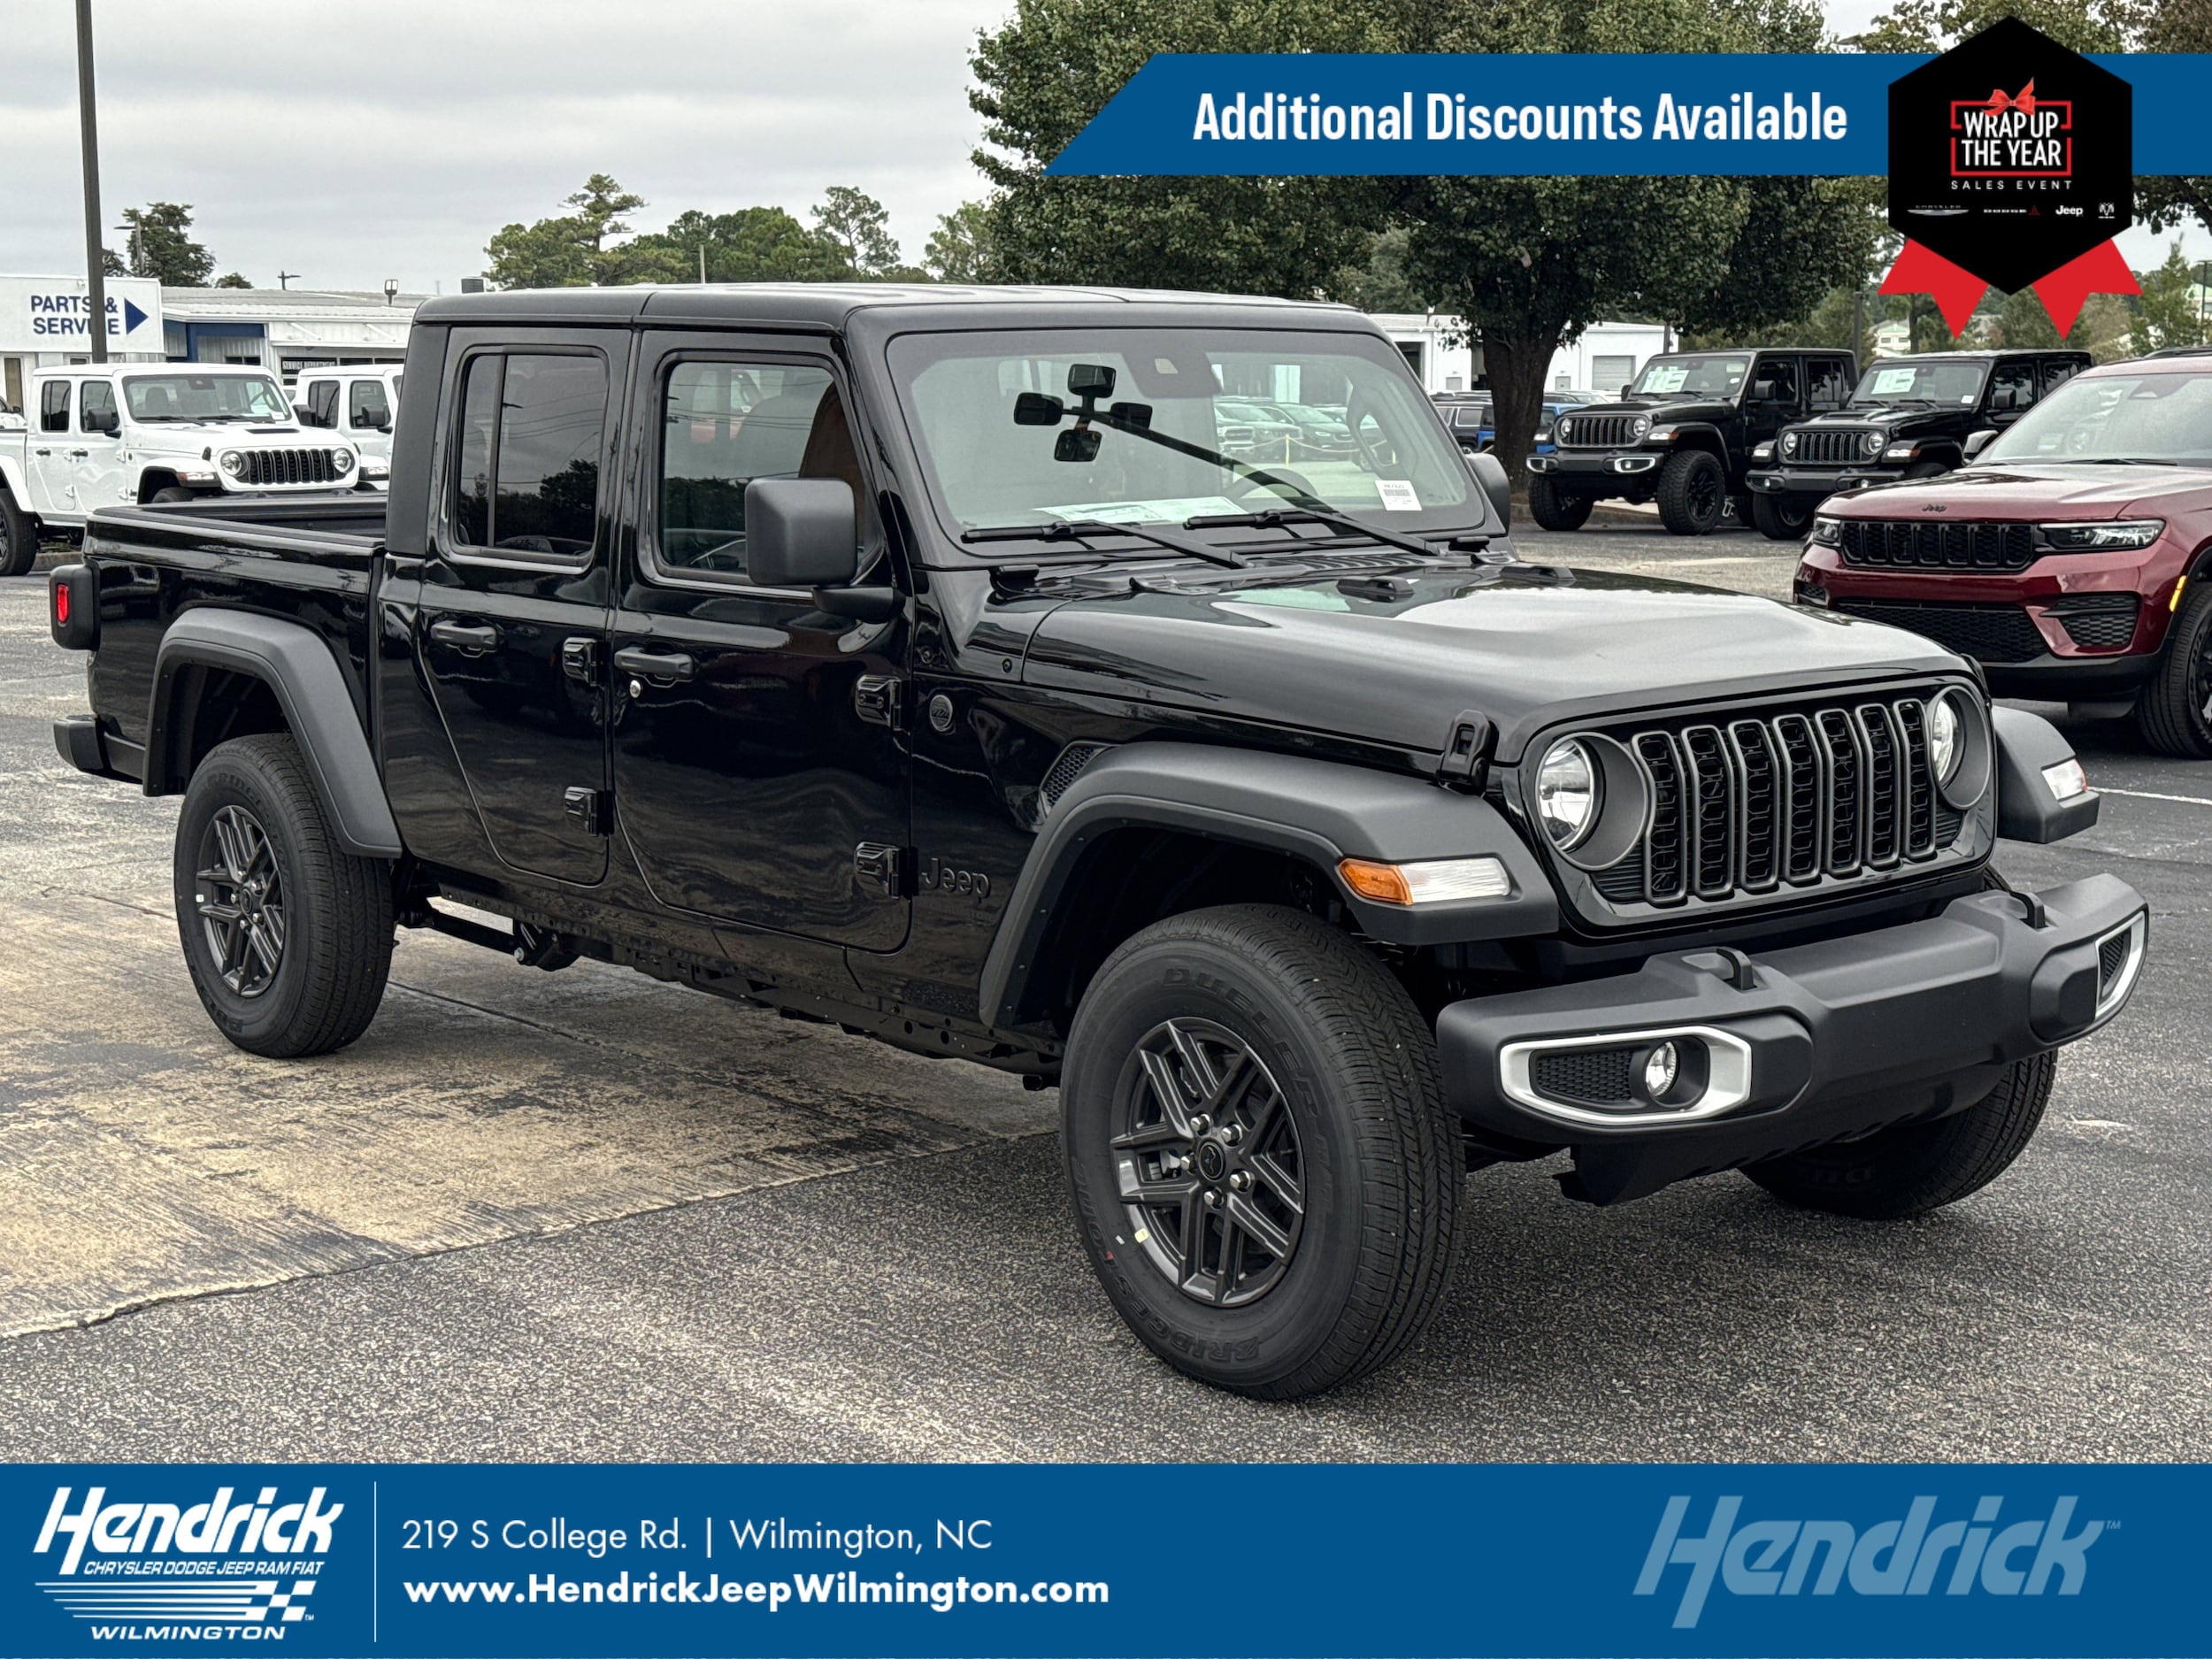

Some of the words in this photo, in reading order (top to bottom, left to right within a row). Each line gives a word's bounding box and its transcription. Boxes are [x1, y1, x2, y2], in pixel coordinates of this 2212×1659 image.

[30, 295, 91, 312] PARTS
[104, 296, 119, 313] &
[33, 317, 120, 335] SERVIE
[920, 856, 992, 904] Jeep
[1160, 965, 1320, 1118] DUELER
